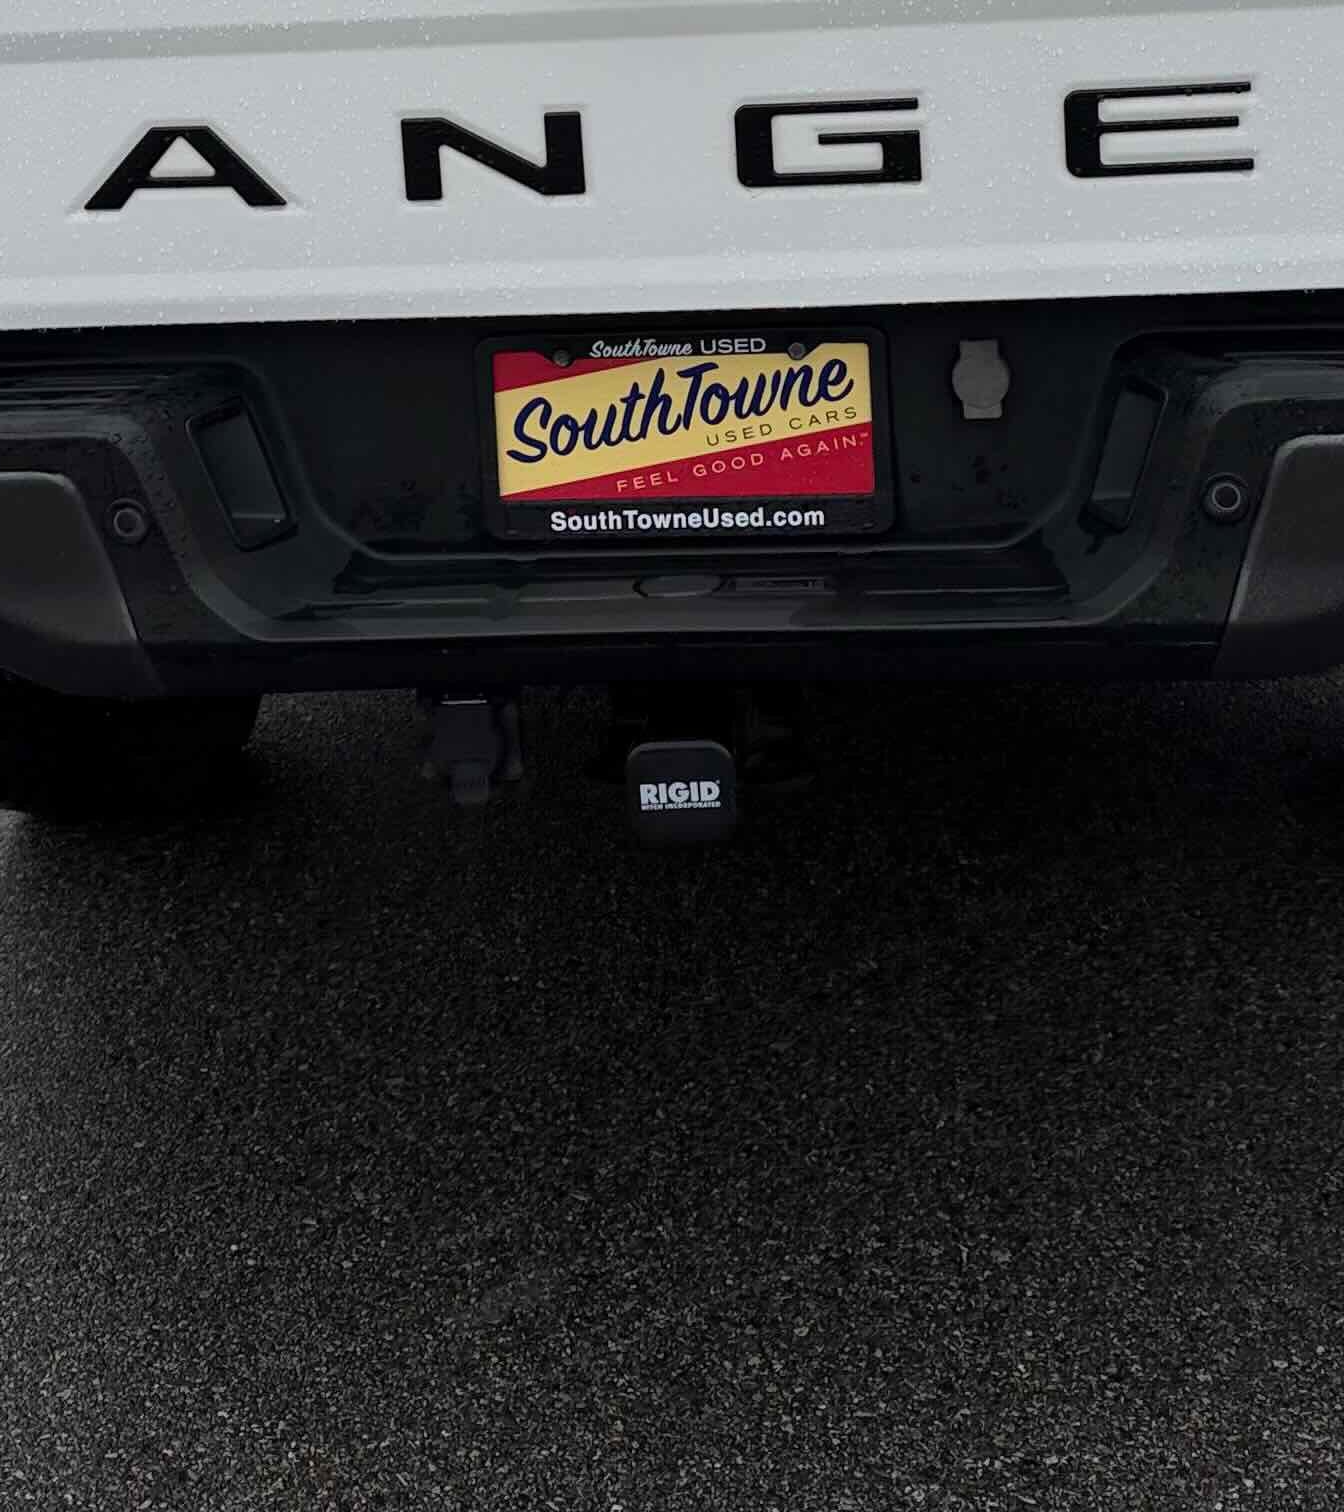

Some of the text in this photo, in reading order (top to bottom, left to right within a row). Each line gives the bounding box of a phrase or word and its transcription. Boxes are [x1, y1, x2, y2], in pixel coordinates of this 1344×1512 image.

[589, 338, 767, 358] SouthTowne USED
[506, 358, 855, 464] SouthTowne
[706, 406, 857, 447] USED CARS
[616, 471, 679, 493] FEEL
[693, 452, 765, 476] GOOD
[550, 508, 825, 532] SouthTowneUsed.com
[639, 781, 720, 803] RIGID
